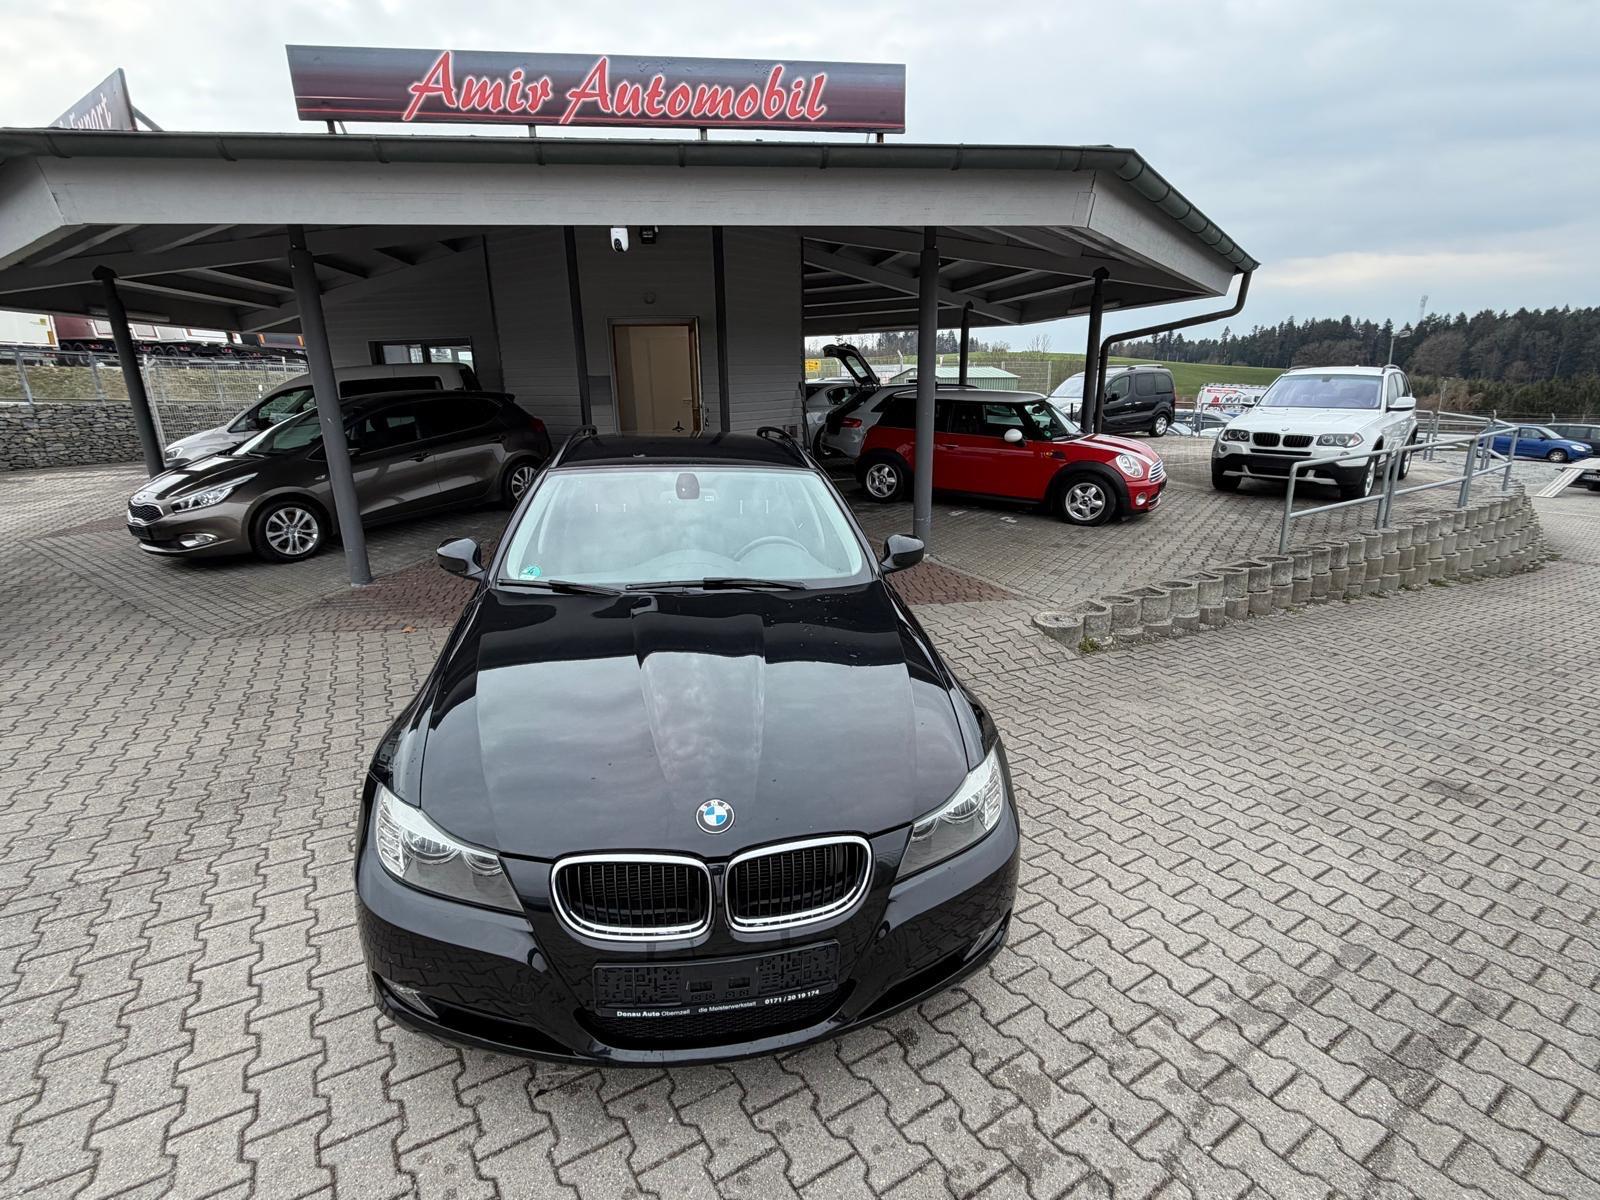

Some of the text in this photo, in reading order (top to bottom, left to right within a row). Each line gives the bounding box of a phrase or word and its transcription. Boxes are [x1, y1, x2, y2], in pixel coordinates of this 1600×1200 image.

[402, 50, 828, 125] Amir Automobil
[764, 997, 782, 1005] 0171
[807, 989, 820, 997] 174
